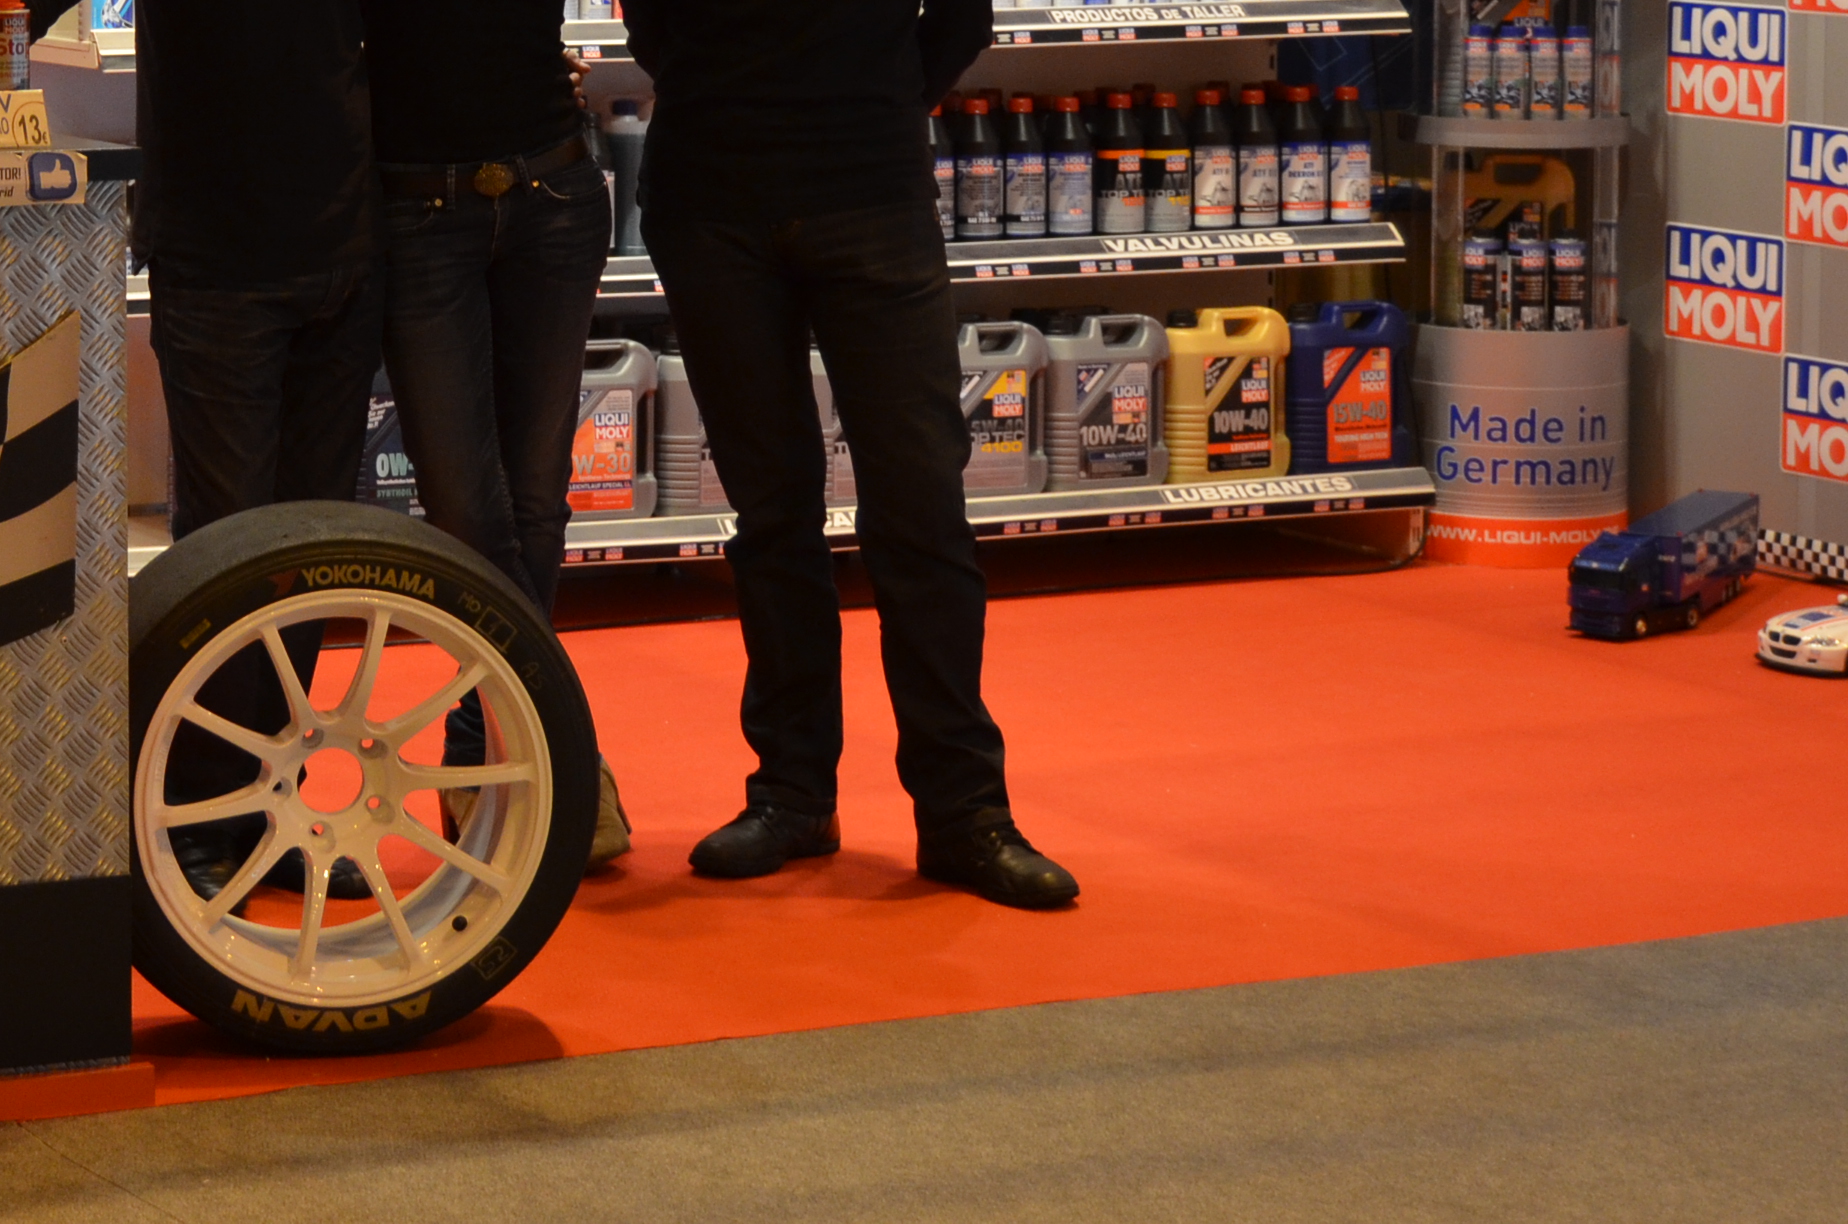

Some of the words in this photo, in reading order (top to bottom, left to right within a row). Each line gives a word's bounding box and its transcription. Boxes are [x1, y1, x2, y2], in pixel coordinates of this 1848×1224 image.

[1053, 5, 1159, 24] PRODUCTOS
[1161, 9, 1181, 20] DE
[1182, 3, 1246, 20] TALLER
[1671, 4, 1780, 62] LIQUI
[1670, 59, 1783, 118] MOLY
[1105, 231, 1296, 253] VALVULINAS
[1669, 228, 1779, 292] LIQUI
[1668, 286, 1781, 347] MOLY
[1114, 386, 1145, 397] LIQUI
[1114, 399, 1146, 411] MOLY
[1332, 401, 1387, 423] 15W-40
[595, 413, 629, 426] LIQUI
[1214, 409, 1268, 433] 10W-40
[1450, 405, 1564, 444] Made
[1579, 406, 1606, 441] in
[595, 427, 629, 440] MOLY
[1081, 424, 1147, 446] 10W-40
[1436, 446, 1615, 491] Germany
[1163, 476, 1353, 504] LUBRICANTES
[302, 565, 436, 600] YOKOHAMA
[231, 990, 431, 1033] ADVAN
